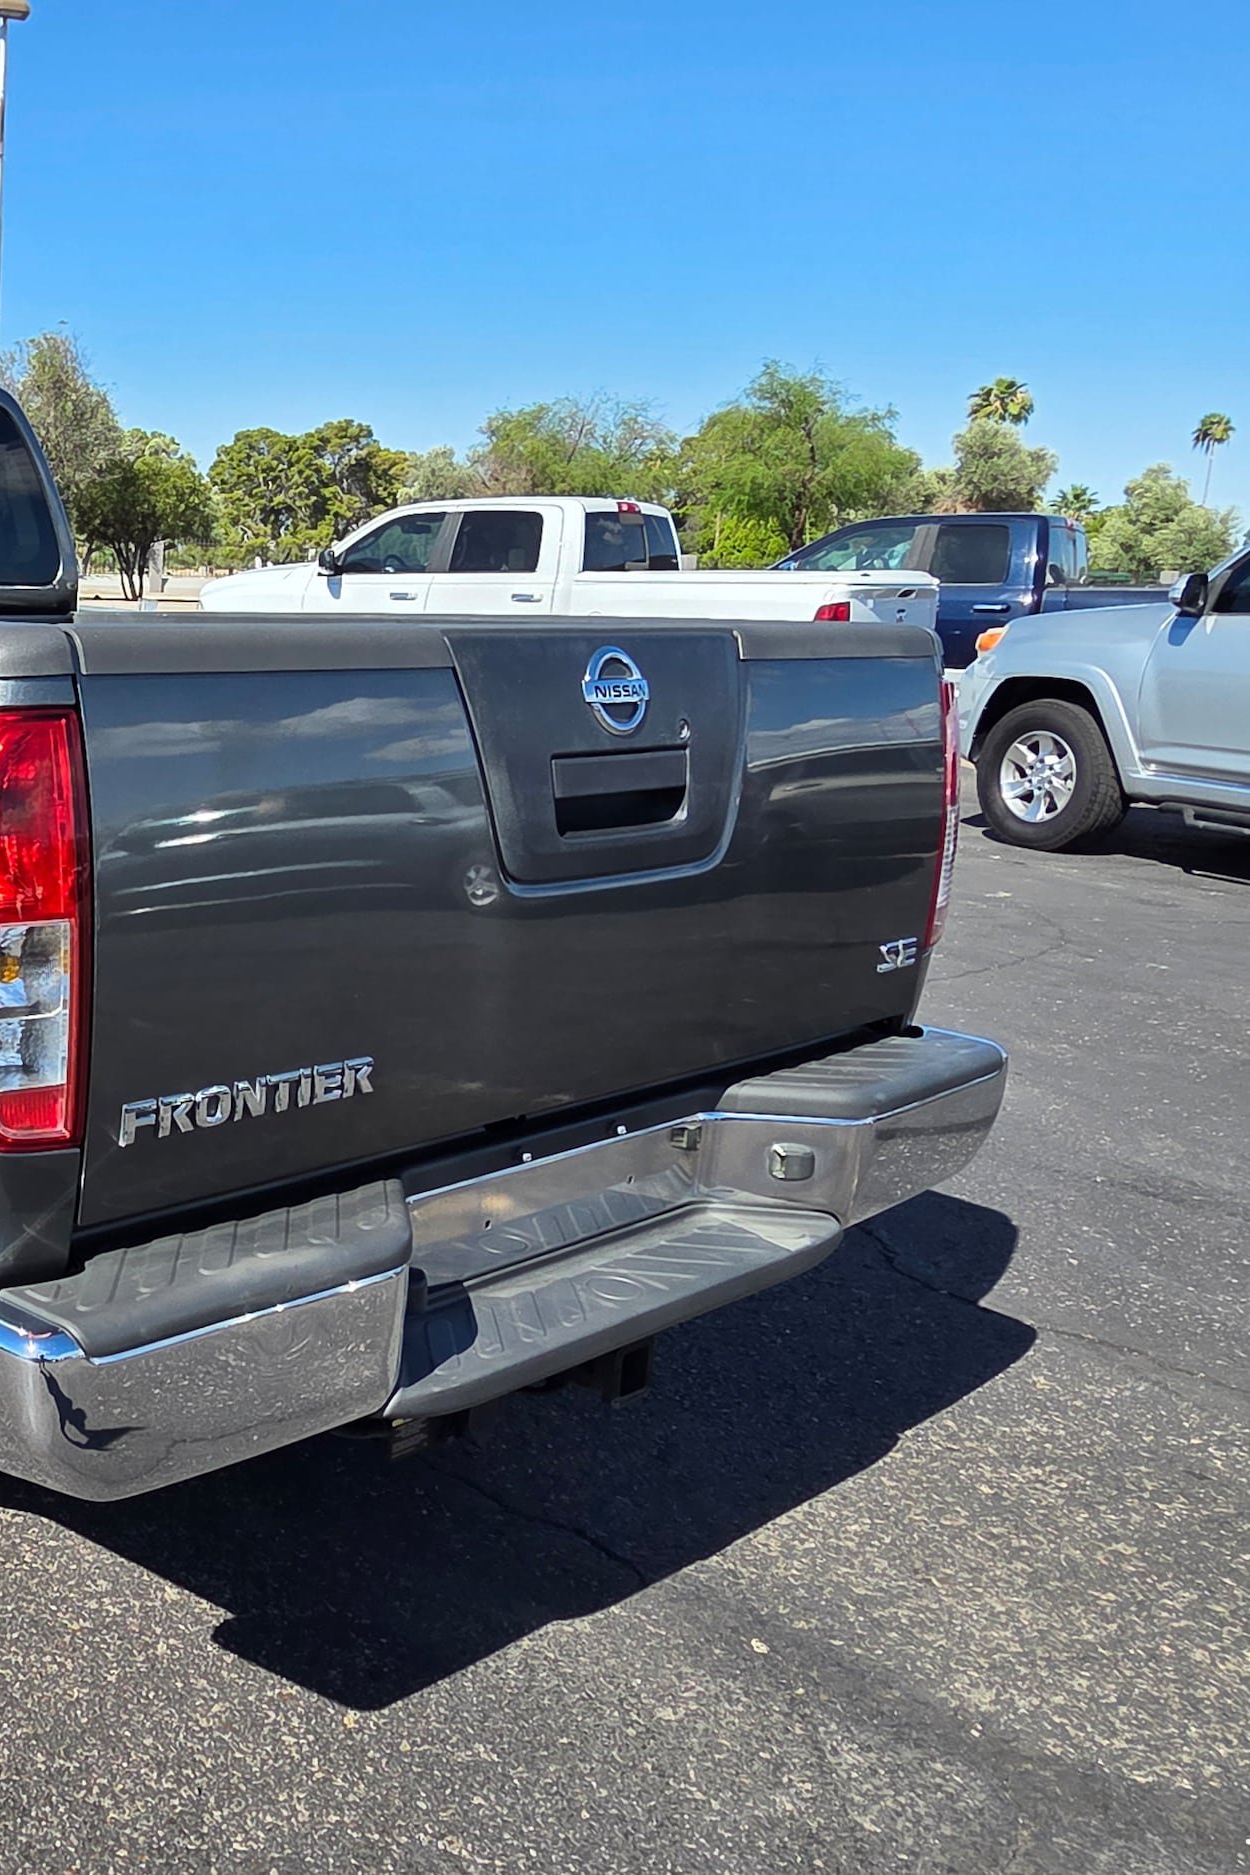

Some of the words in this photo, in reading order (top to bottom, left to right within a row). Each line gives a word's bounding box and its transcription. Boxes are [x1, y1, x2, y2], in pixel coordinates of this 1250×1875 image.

[594, 684, 646, 699] NISSAN
[876, 936, 919, 974] SE
[117, 1056, 375, 1147] FRONTIER
